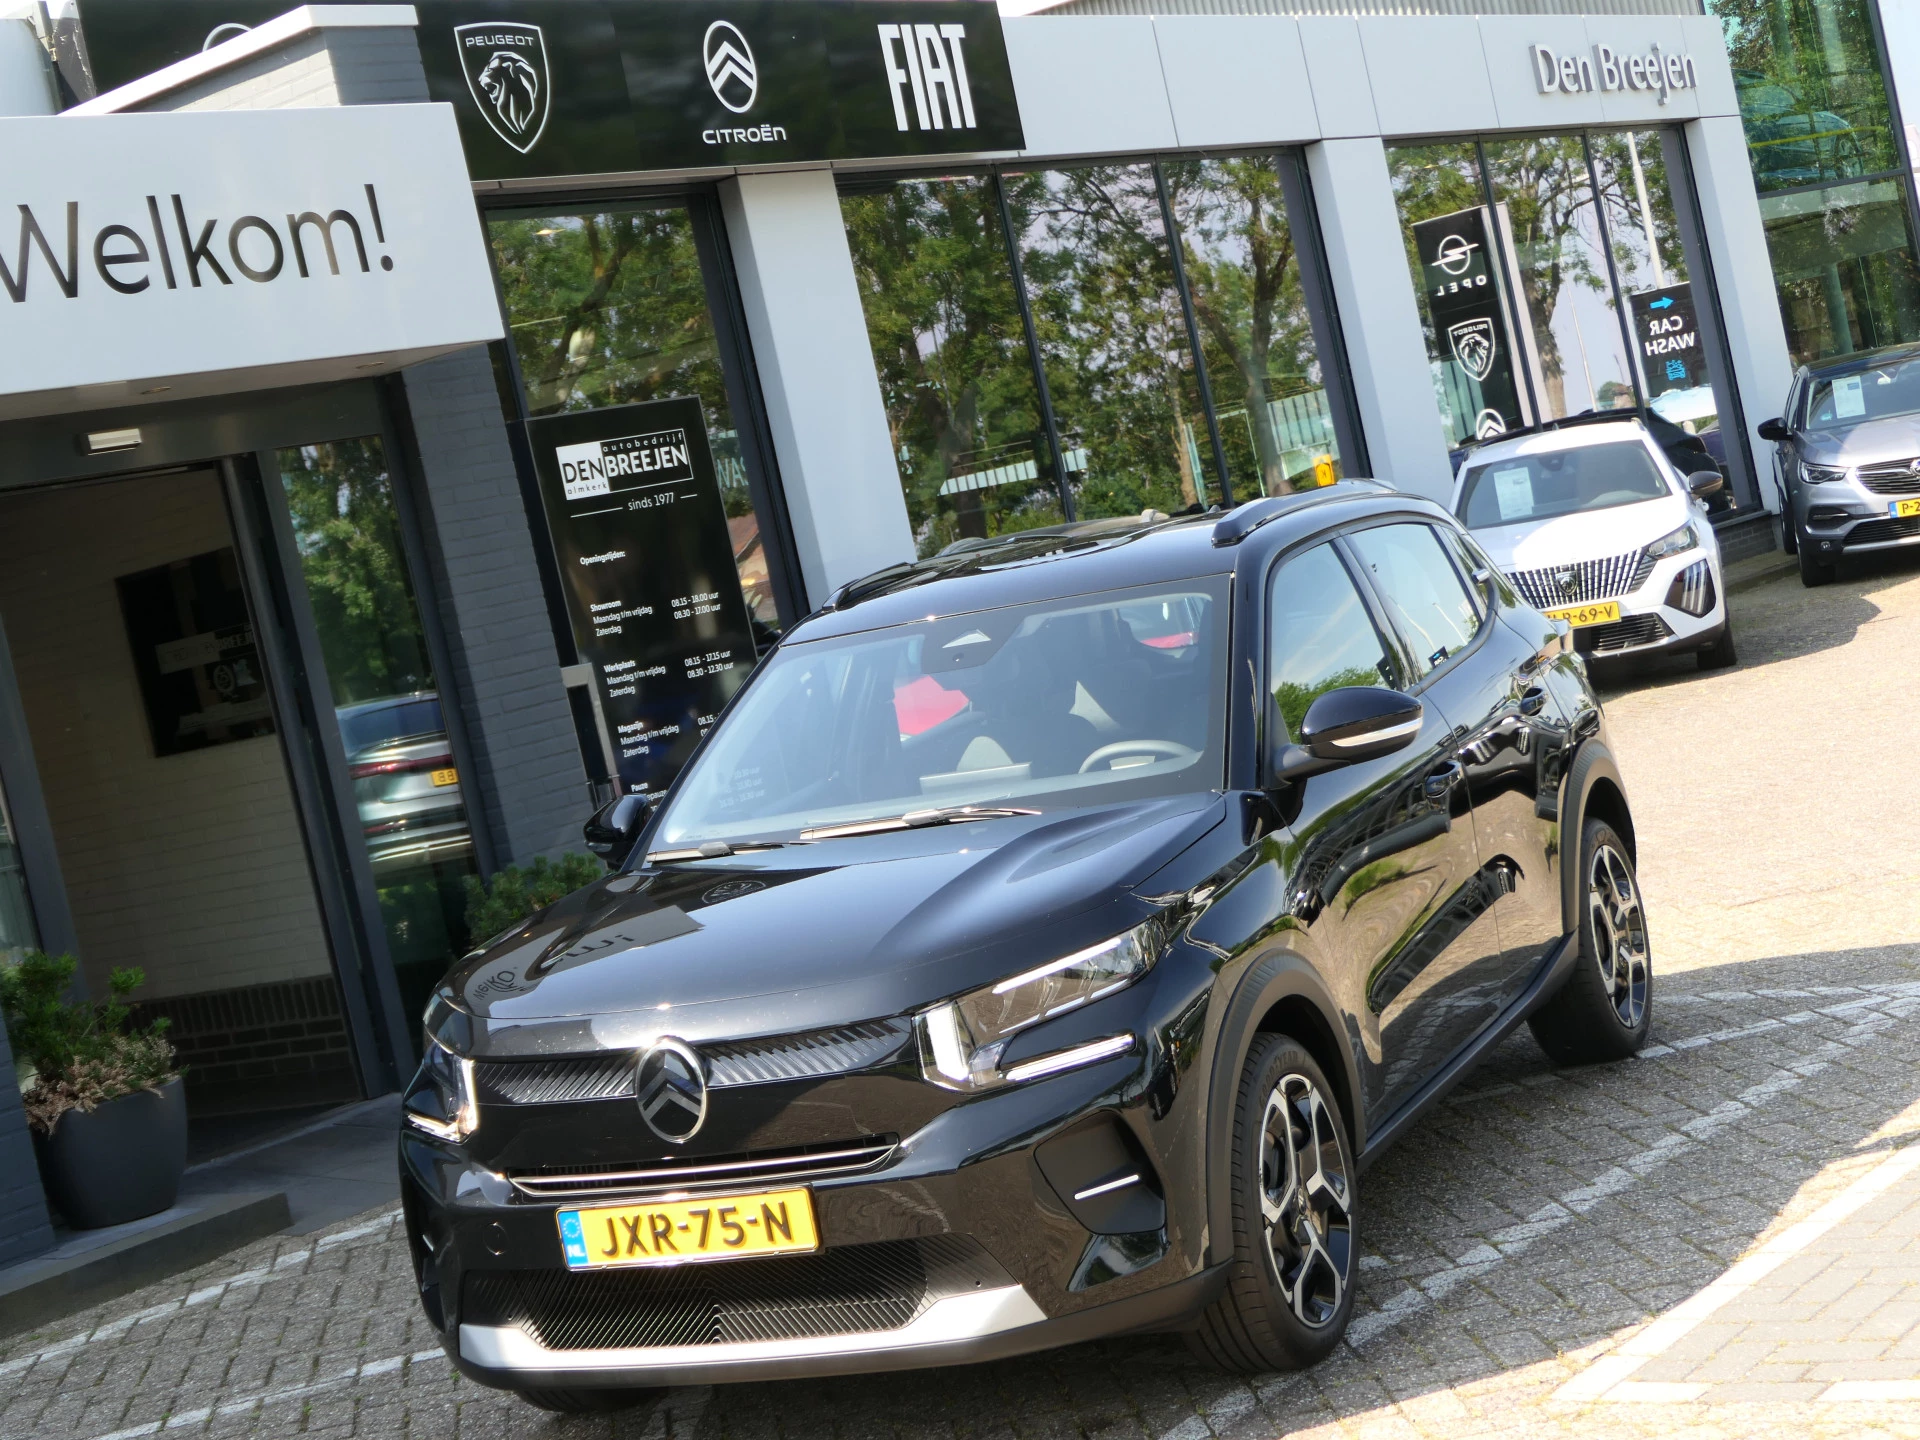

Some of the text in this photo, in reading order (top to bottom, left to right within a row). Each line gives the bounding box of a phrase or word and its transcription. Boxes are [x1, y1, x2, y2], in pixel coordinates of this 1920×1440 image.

[465, 34, 534, 48] PEUGEOT
[877, 23, 976, 132] FIAT
[1530, 41, 1699, 106] Den Breejen
[0, 183, 394, 304] Welkom!
[602, 432, 682, 453] autobedrijf
[561, 444, 689, 484] DEN BREEJEN
[567, 482, 607, 495] almkerk
[628, 492, 674, 511] sinds 1977
[590, 600, 622, 612] Showroom
[593, 612, 621, 624] Maandag
[632, 606, 653, 617] vrijdag
[708, 592, 719, 600] uur
[596, 625, 623, 637] Zaterdag
[710, 603, 721, 611] uur
[603, 660, 636, 673] Werkplaats
[606, 673, 635, 685] Maandag
[646, 665, 667, 677] vrijdag
[720, 650, 731, 658] uur
[609, 685, 635, 698] Zaterdag
[723, 662, 734, 670] uur
[617, 721, 644, 734] Magazijn
[620, 734, 648, 746] Maandag
[659, 724, 680, 736] vrijdag
[623, 745, 649, 758] Zaterdag
[631, 782, 648, 793] Pauze
[601, 1201, 793, 1258] JXR-75-N
[566, 1244, 586, 1258] NL
